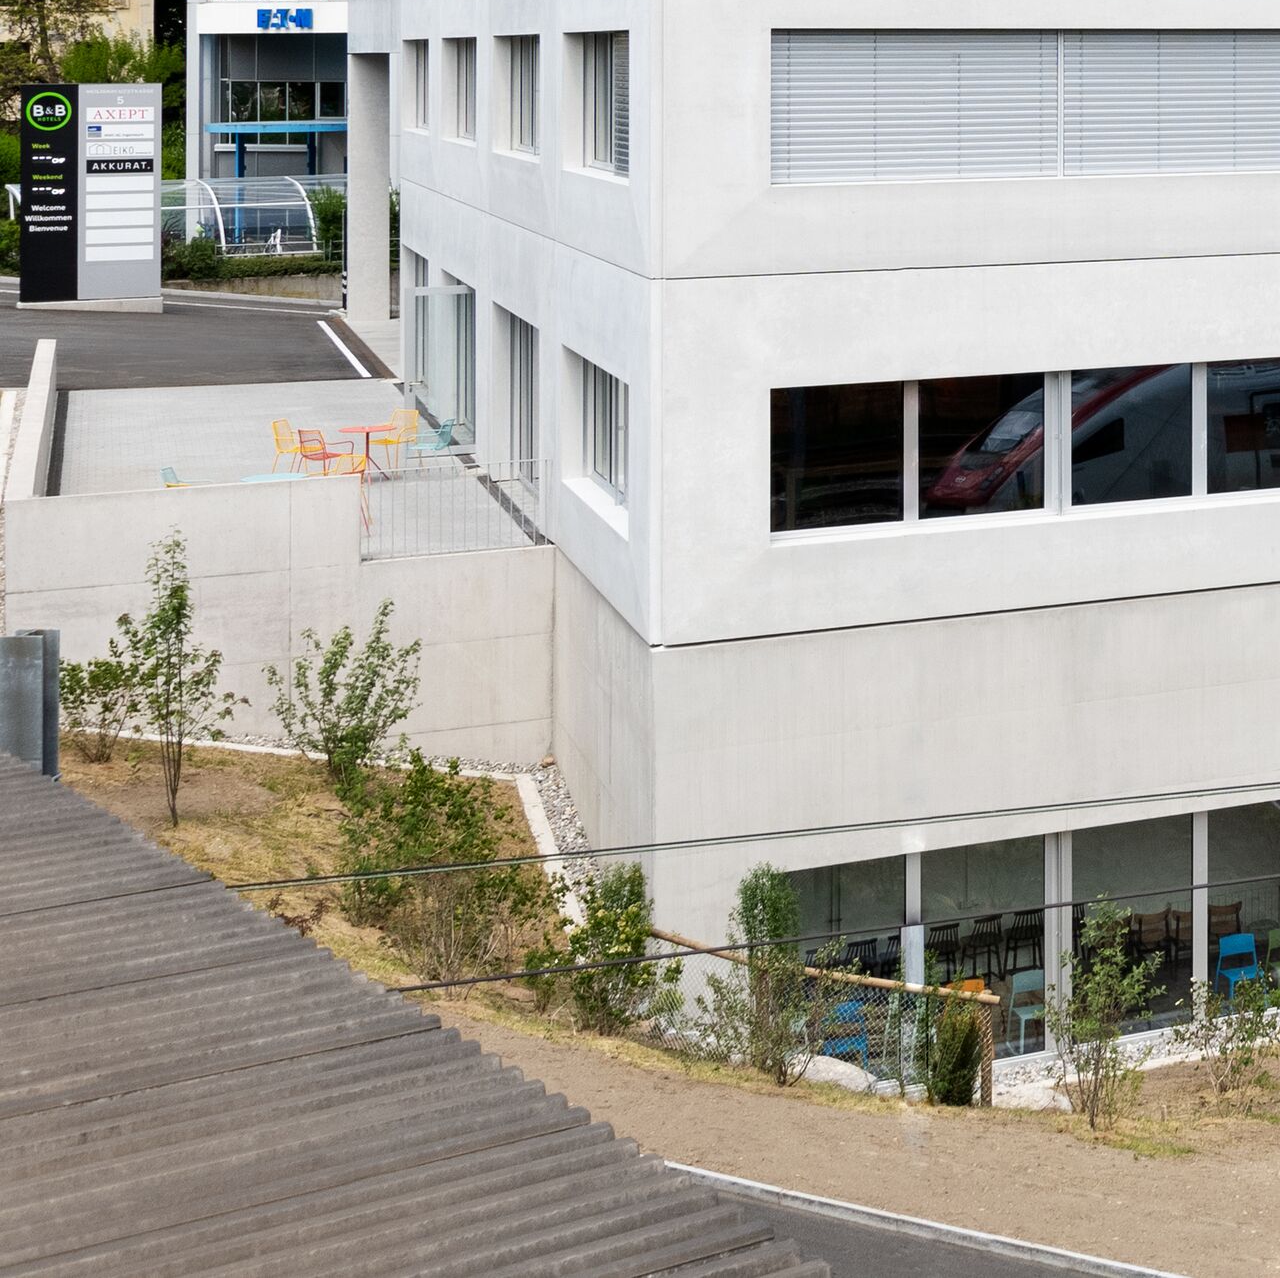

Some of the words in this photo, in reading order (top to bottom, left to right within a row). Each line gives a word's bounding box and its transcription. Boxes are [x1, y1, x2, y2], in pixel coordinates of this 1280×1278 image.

[117, 96, 124, 105] 5
[32, 104, 67, 117] B&B
[93, 109, 149, 120] AXEPT
[113, 146, 135, 155] EIKO
[92, 161, 151, 171] AKKURAT.
[31, 204, 67, 212] Welcome
[24, 214, 73, 222] Willkommen
